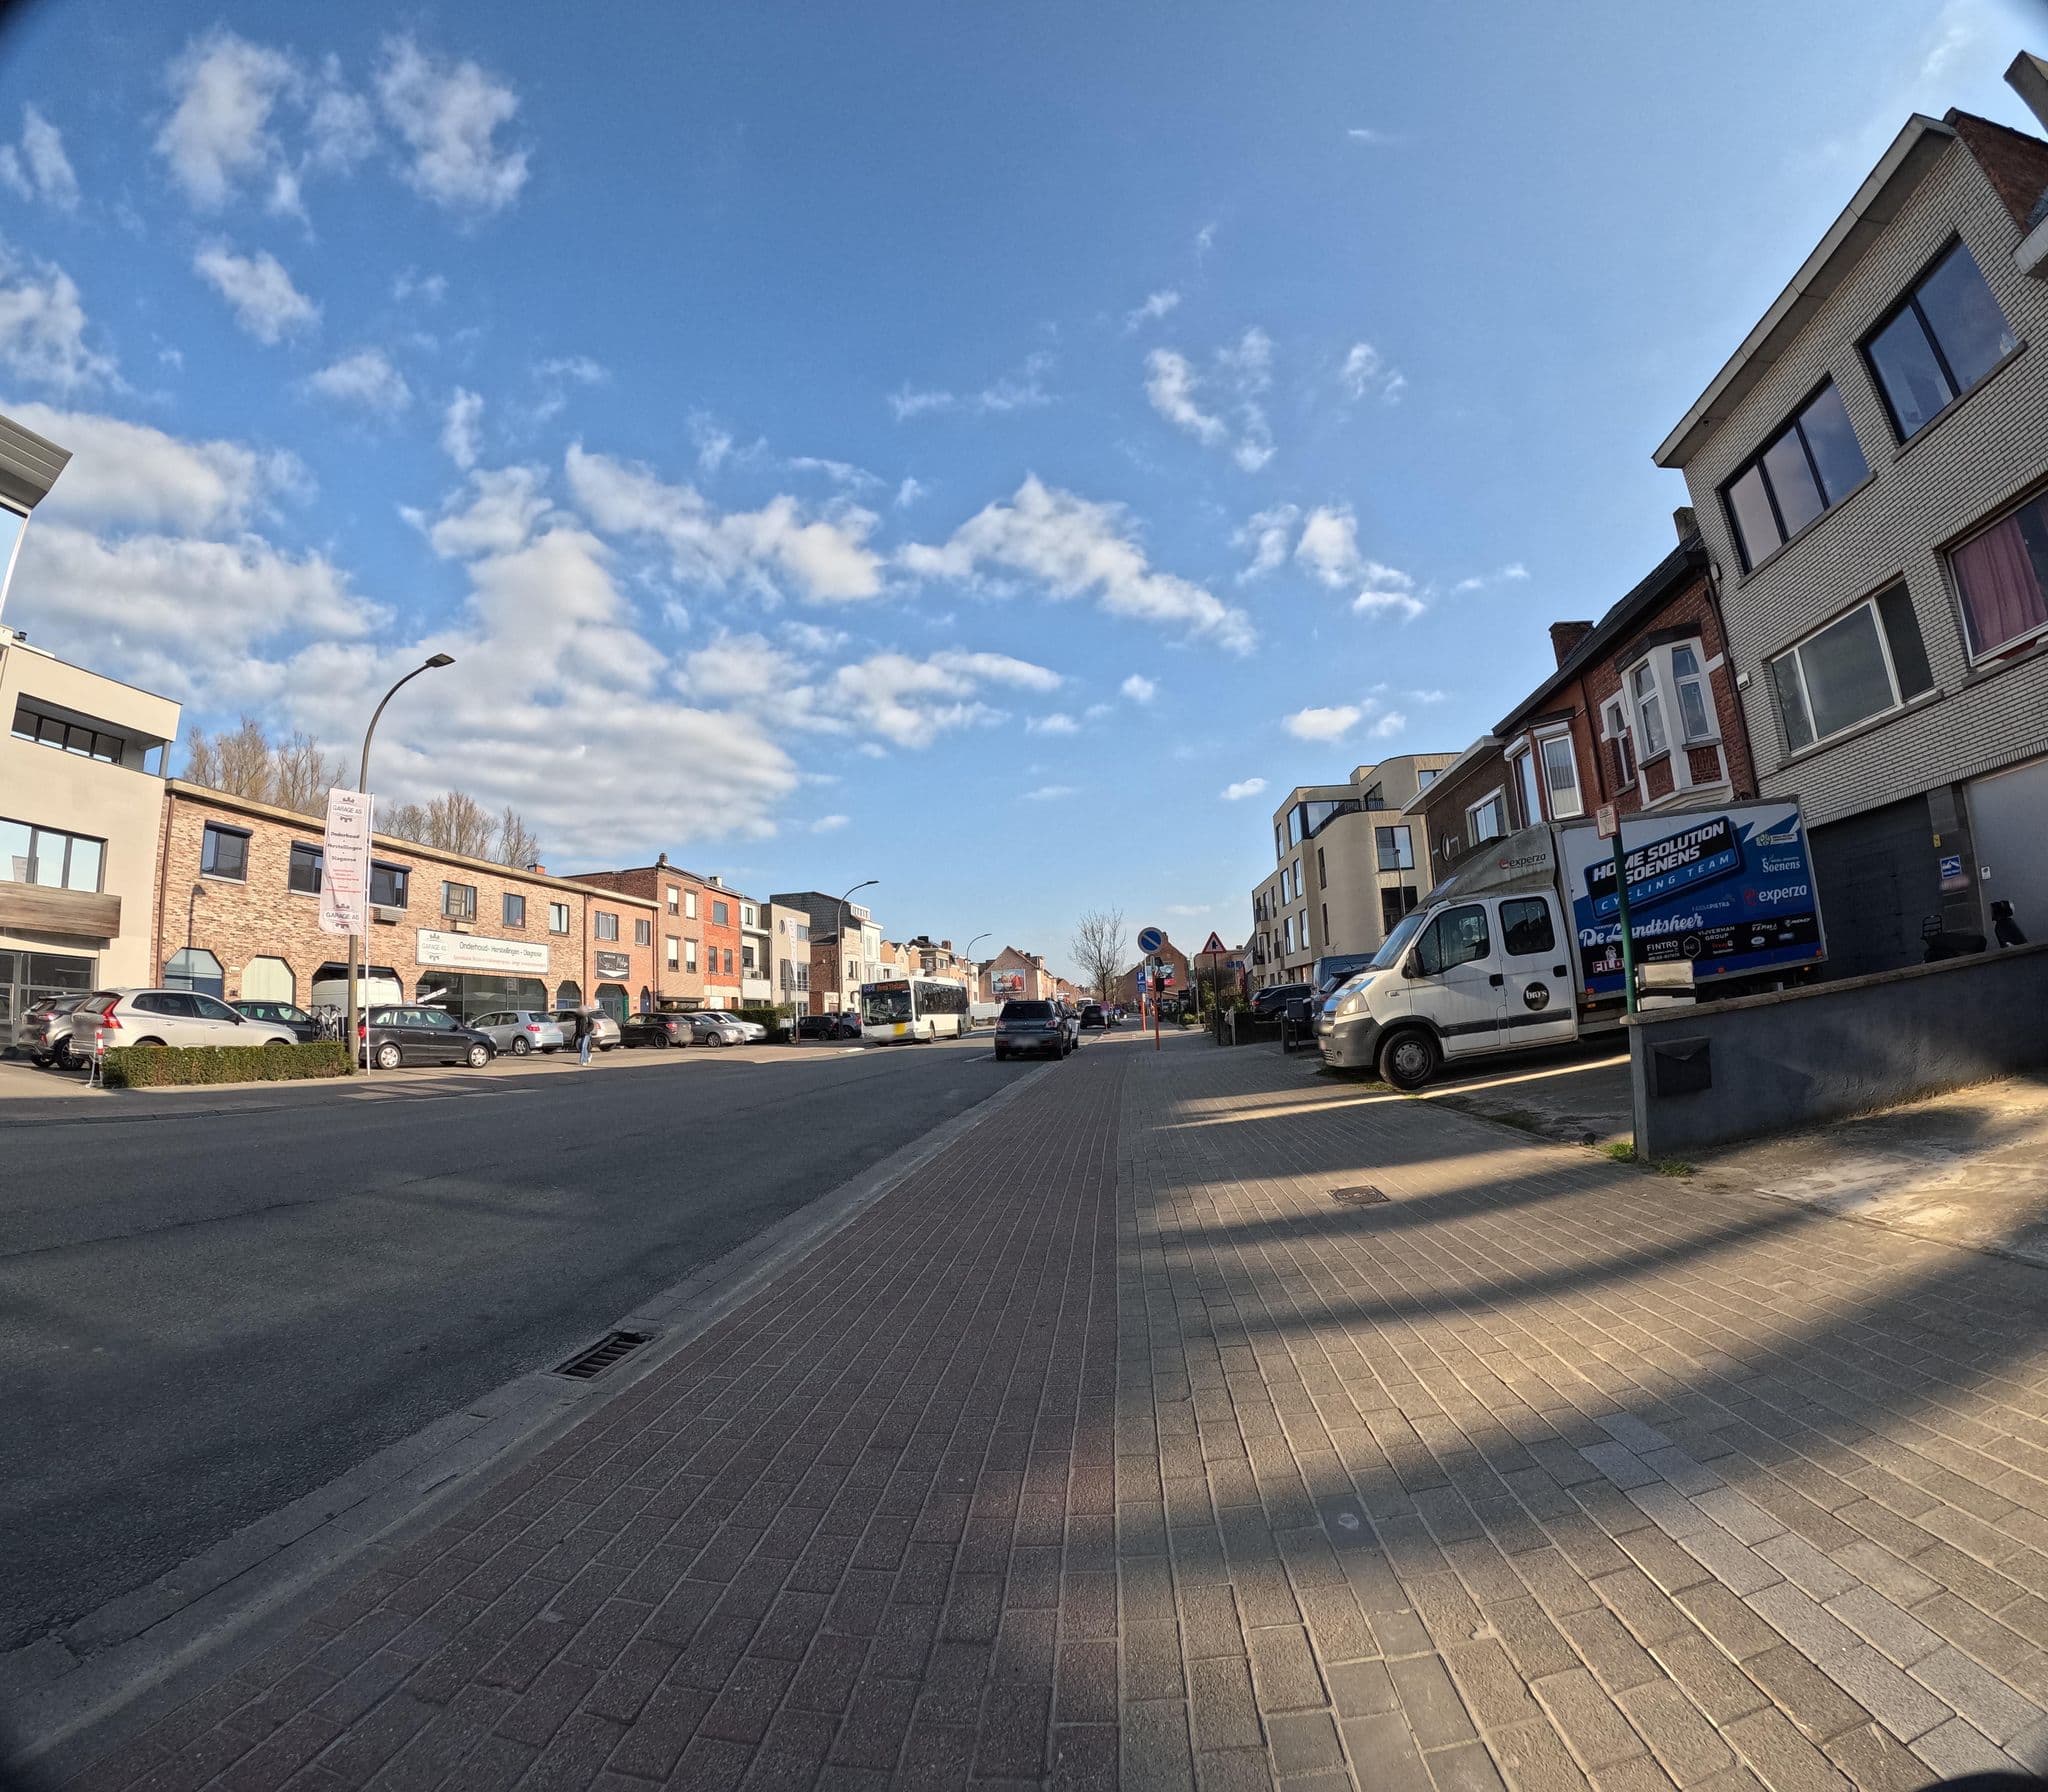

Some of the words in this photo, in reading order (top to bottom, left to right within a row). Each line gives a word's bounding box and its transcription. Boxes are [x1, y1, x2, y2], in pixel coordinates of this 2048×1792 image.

[1509, 853, 1546, 868] experza
[1593, 851, 1644, 882] HOME
[1648, 821, 1724, 862] SOLUTION
[1625, 845, 1700, 885] SOENENS
[1687, 854, 1729, 877] TEAM
[1762, 857, 1801, 873] Soenens
[1758, 885, 1807, 905] experza
[1579, 928, 1604, 947] De
[1647, 941, 1678, 951] FINTRO
